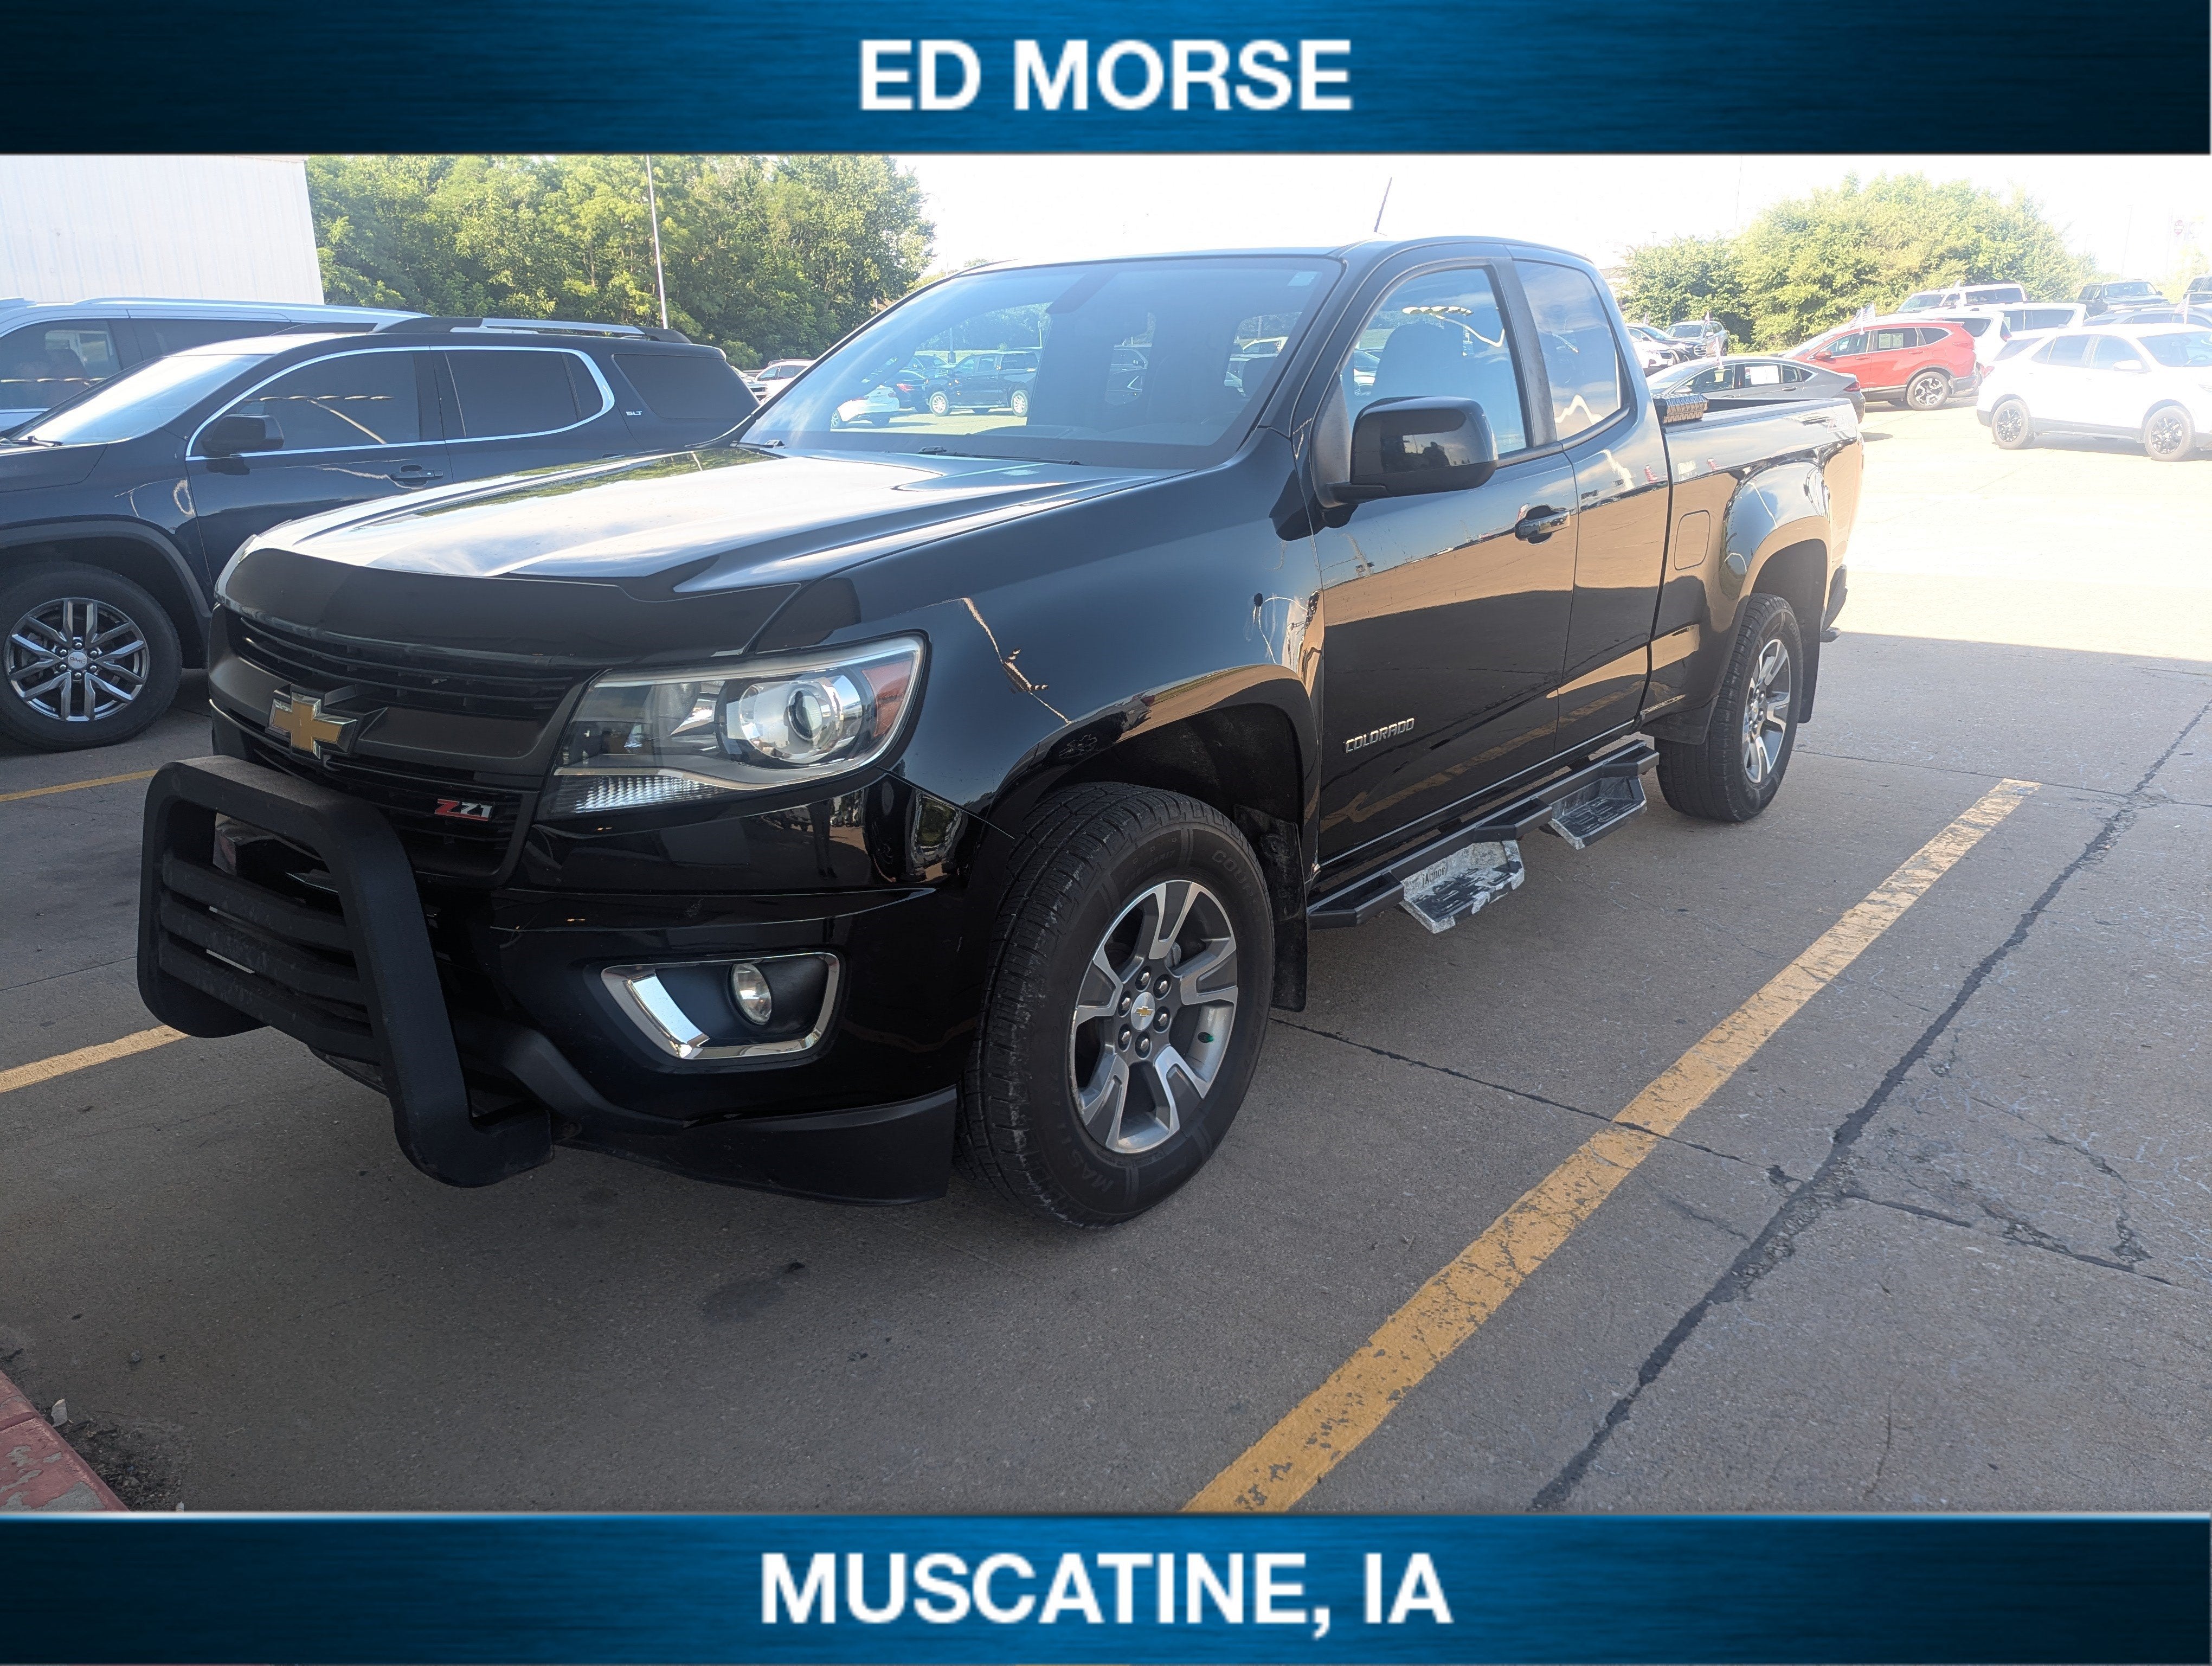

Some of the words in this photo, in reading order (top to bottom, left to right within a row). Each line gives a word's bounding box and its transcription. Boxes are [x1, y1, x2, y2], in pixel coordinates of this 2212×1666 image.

[1345, 717, 1414, 753] COLORADO
[434, 798, 492, 822] Z71
[1422, 866, 1445, 888] iArmor
